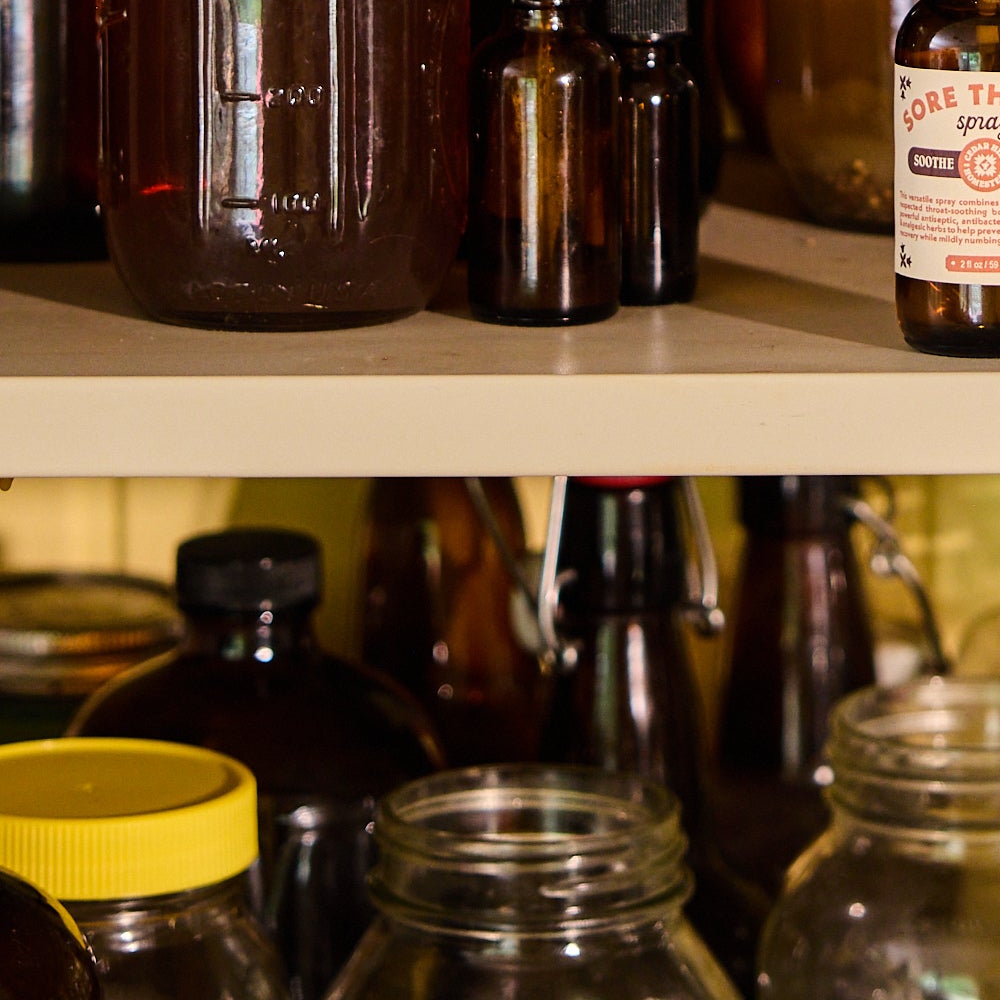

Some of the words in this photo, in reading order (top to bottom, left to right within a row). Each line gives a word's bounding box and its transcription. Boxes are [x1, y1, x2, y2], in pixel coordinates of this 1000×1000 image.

[903, 86, 957, 132] SORE
[964, 142, 990, 161] CEDAR
[913, 154, 954, 170] SOOTHE
[909, 195, 933, 203] versatile
[936, 198, 956, 207] spray
[959, 198, 999, 206] combines
[926, 205, 987, 217] throat-soothing
[922, 216, 958, 225] antiseptic,
[926, 224, 945, 232] herbs
[958, 226, 975, 237] help
[920, 233, 937, 242] while
[939, 236, 963, 245] mildly
[960, 260, 965, 269] 2
[966, 260, 972, 269] fl
[984, 260, 987, 269] /
[989, 260, 998, 269] 59
